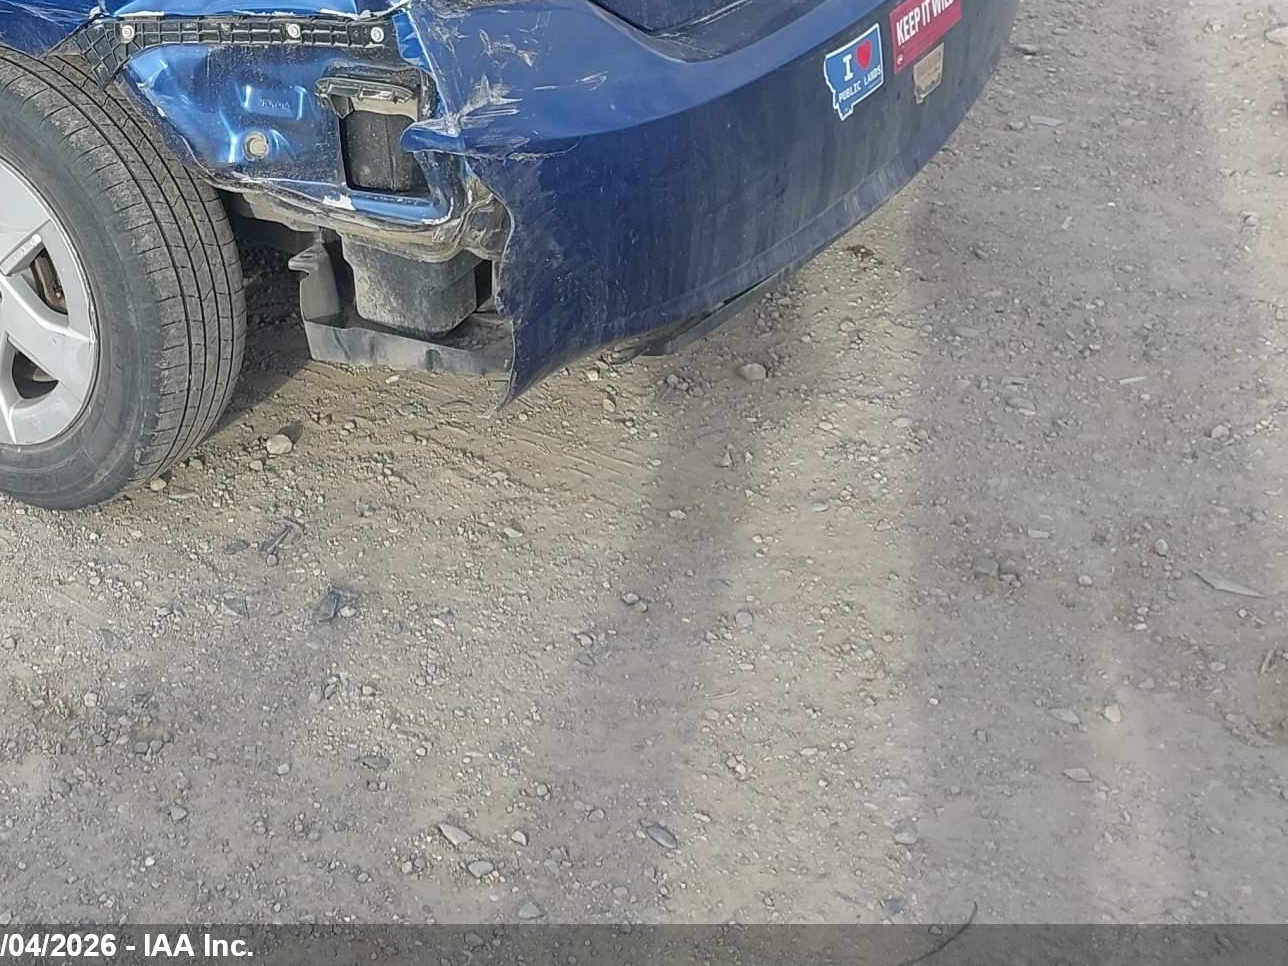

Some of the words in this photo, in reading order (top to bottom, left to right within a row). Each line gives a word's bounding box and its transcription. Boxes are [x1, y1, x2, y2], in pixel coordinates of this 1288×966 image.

[896, 5, 921, 47] KEEP
[838, 80, 862, 103] PUBLIC
[864, 64, 881, 86] LANDS
[842, 54, 854, 82] I
